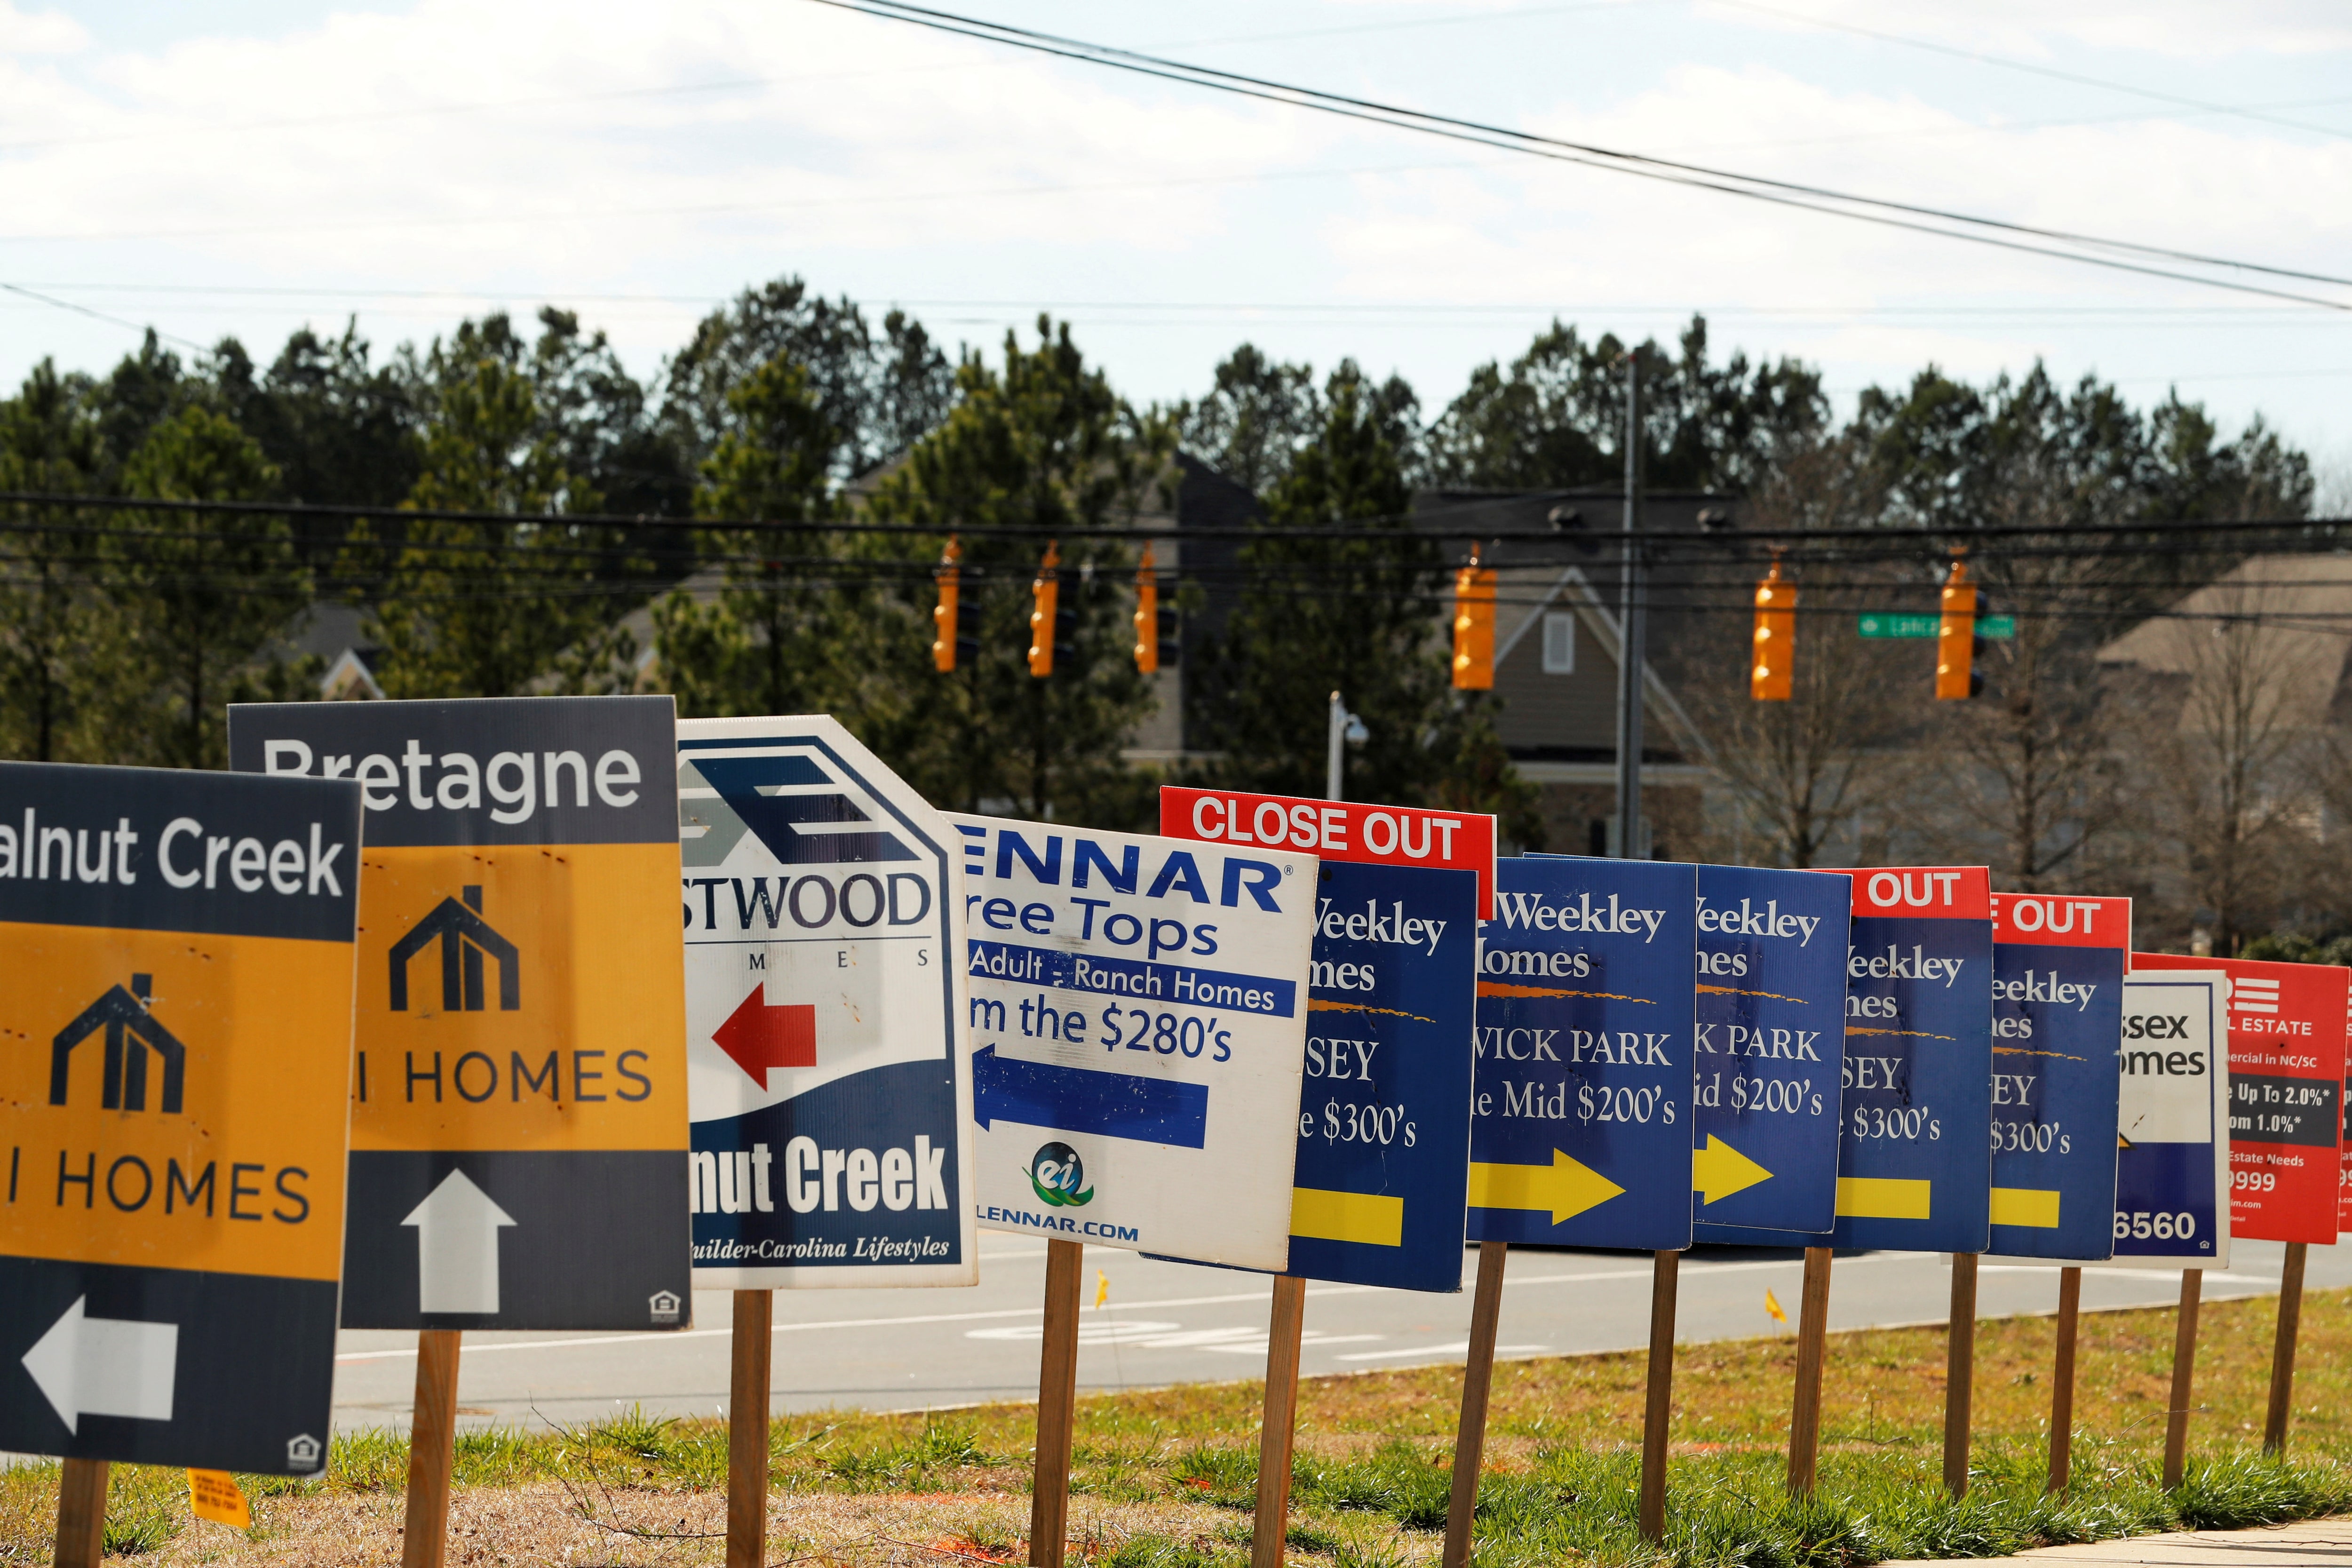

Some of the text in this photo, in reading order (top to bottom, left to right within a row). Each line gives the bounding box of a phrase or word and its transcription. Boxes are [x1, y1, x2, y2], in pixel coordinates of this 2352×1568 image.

[1192, 796, 1461, 860] CLOSE OUT
[158, 817, 344, 896] Creek
[1868, 872, 1961, 907] OUT
[966, 894, 1218, 960] ree Tops
[1497, 892, 1666, 944] Weekley
[1697, 897, 1821, 947] eekley
[2013, 899, 2101, 933] OUT
[969, 945, 1042, 980] Adult
[1075, 958, 1161, 996] Ranch
[1174, 971, 1275, 1011] Homes
[1478, 937, 1590, 978] omes
[1849, 944, 1964, 988] eekley
[1019, 994, 1087, 1043] the
[1101, 1002, 1232, 1062] $280's
[1726, 1025, 1821, 1062] PARK
[2242, 1017, 2312, 1036] ESTATE
[1306, 1036, 1379, 1081] SEY
[1570, 1030, 1672, 1066] PARK
[2121, 1051, 2206, 1075] mes
[2227, 1052, 2317, 1068] ercial in NC/SC
[406, 1050, 652, 1103] HOMES
[1731, 1072, 1822, 1116] $200's
[2239, 1082, 2258, 1105] Up
[2263, 1085, 2280, 1103] To
[1324, 1097, 1416, 1147] $300's
[1472, 1080, 1675, 1126] e Mid $200's
[1853, 1103, 1940, 1143] $300's
[1991, 1117, 2070, 1155] $300's
[690, 1135, 949, 1214] nut Creek
[2230, 1151, 2304, 1167] Estate Needs
[56, 1149, 310, 1223] HOMES
[976, 1204, 1138, 1242] LENNAR.COM
[2114, 1211, 2195, 1240] 6560
[690, 1237, 949, 1263] uilder-Carolina Lifestyles
